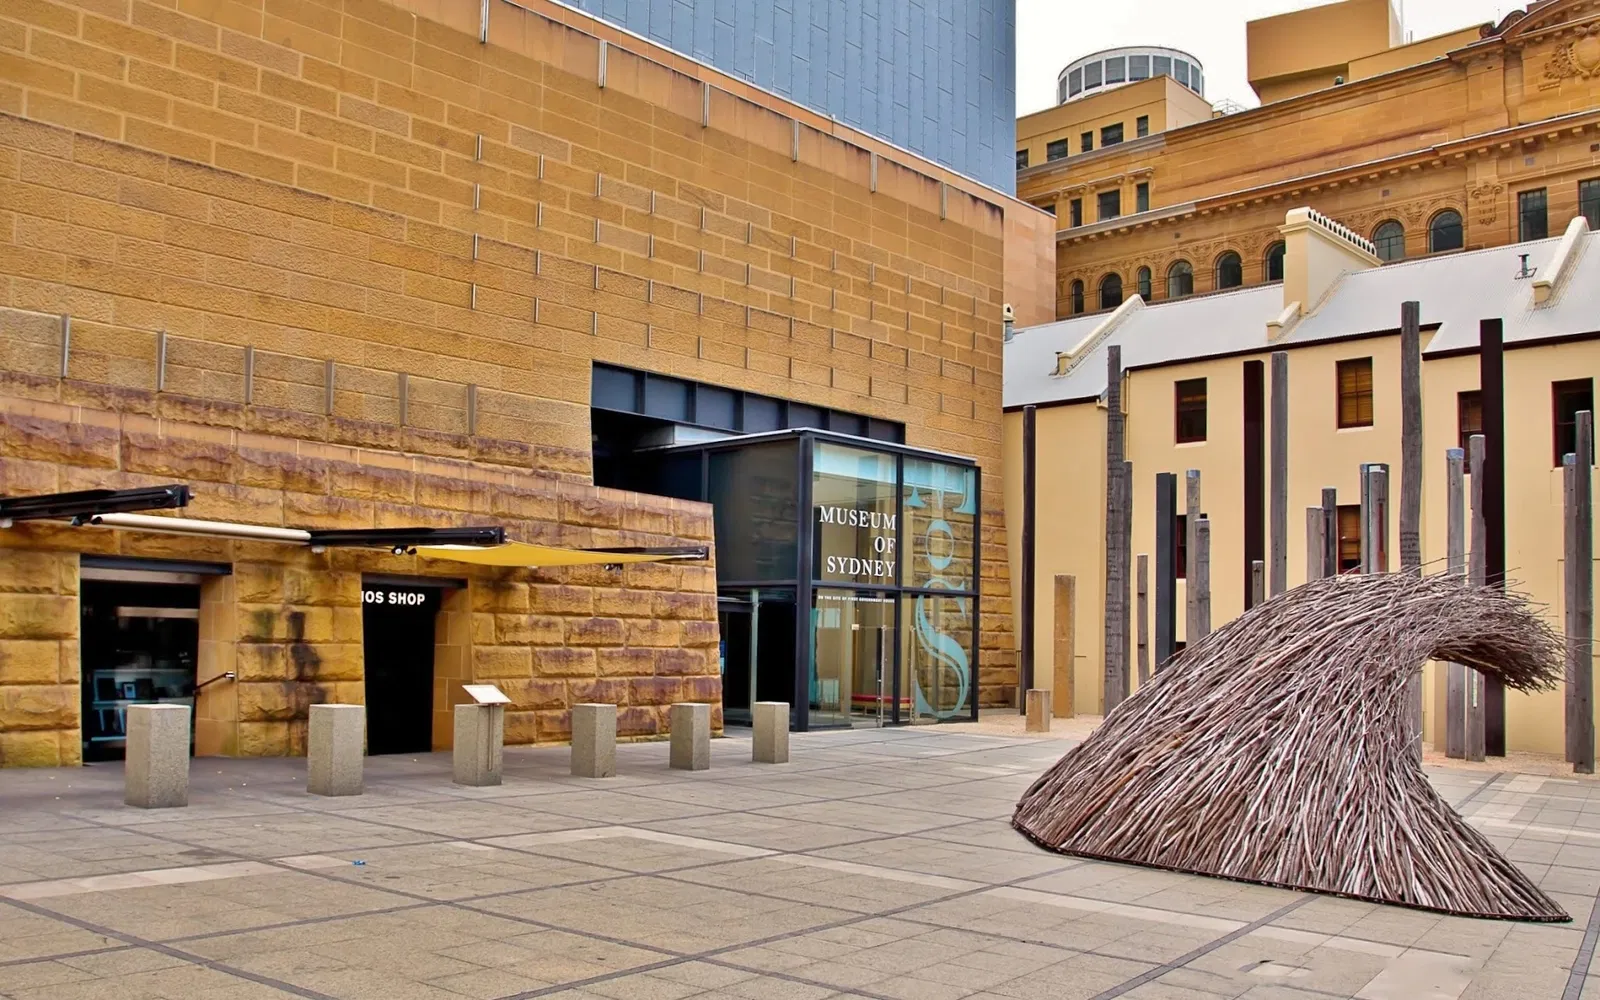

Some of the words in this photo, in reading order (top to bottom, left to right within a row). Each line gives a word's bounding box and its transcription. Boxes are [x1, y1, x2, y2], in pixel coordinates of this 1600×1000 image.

[819, 505, 896, 530] MUSEUM
[874, 536, 896, 553] OF
[827, 556, 895, 577] SYDNEY
[388, 592, 425, 605] SHOP
